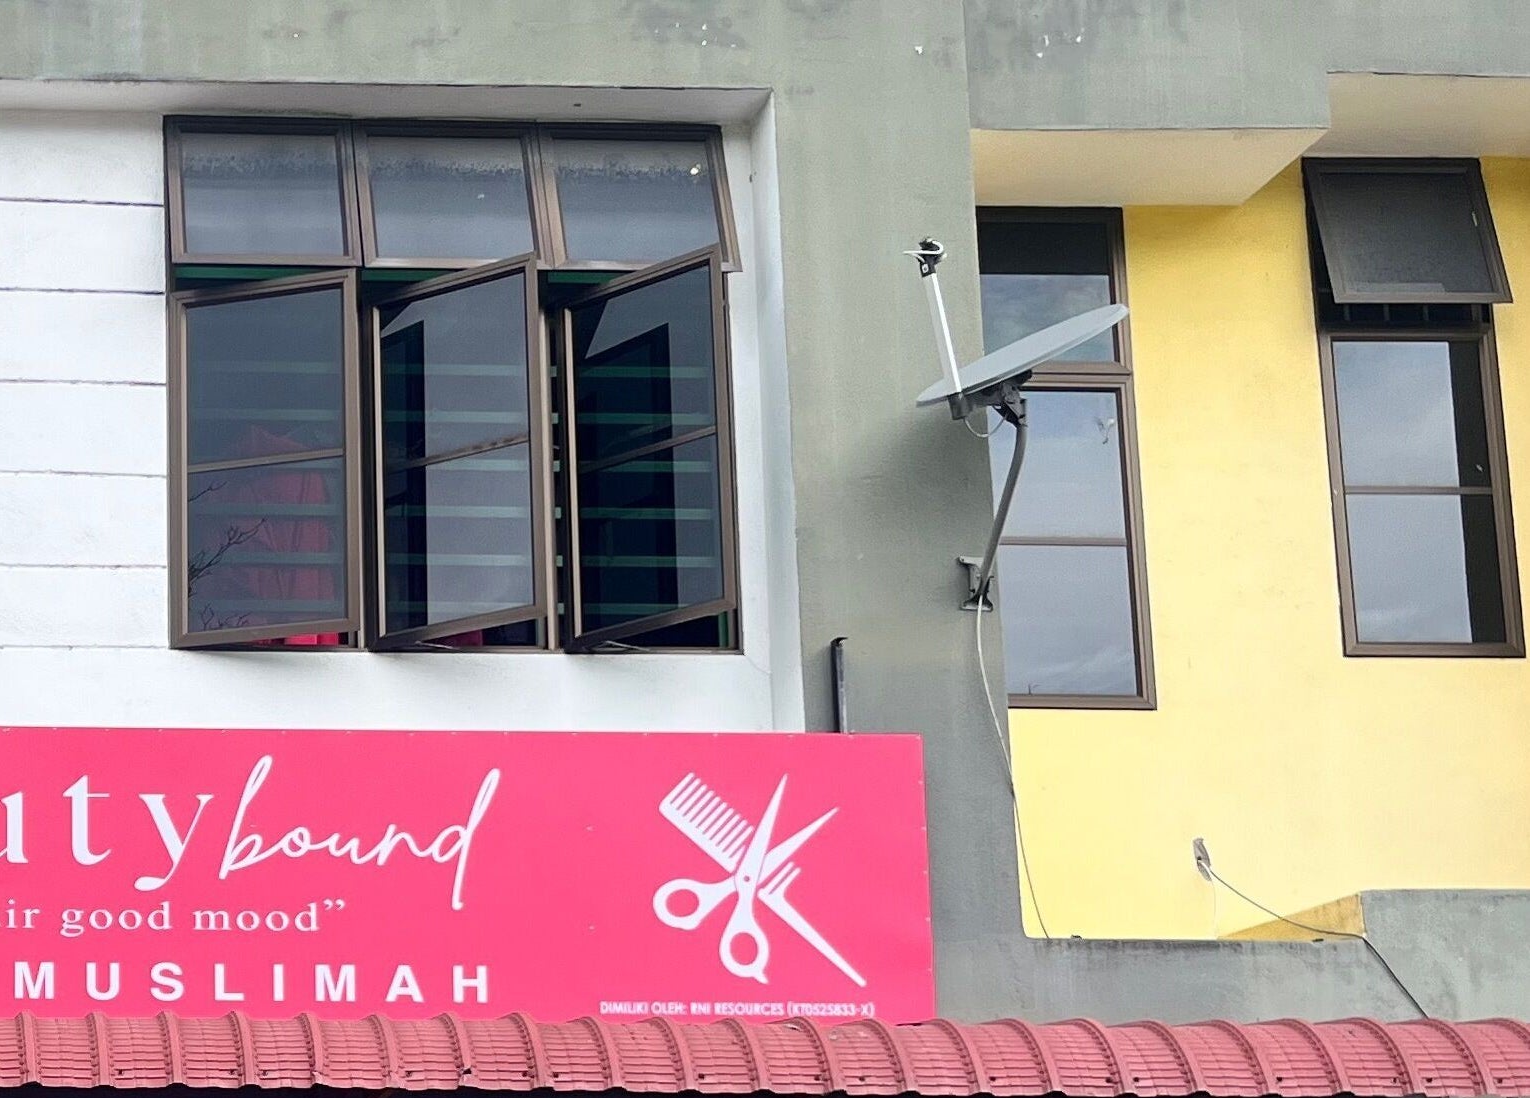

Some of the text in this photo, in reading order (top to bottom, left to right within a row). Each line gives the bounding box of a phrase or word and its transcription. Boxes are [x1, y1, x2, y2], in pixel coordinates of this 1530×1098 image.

[218, 754, 501, 911] bound
[60, 900, 172, 938] good
[193, 898, 346, 932] mood”
[14, 961, 488, 1004] MUSLIMAH
[600, 1001, 649, 1015] DIMILIKI
[651, 1001, 687, 1015] OLEH:
[690, 1001, 711, 1015] RNI
[714, 1001, 786, 1017] RESOURCES
